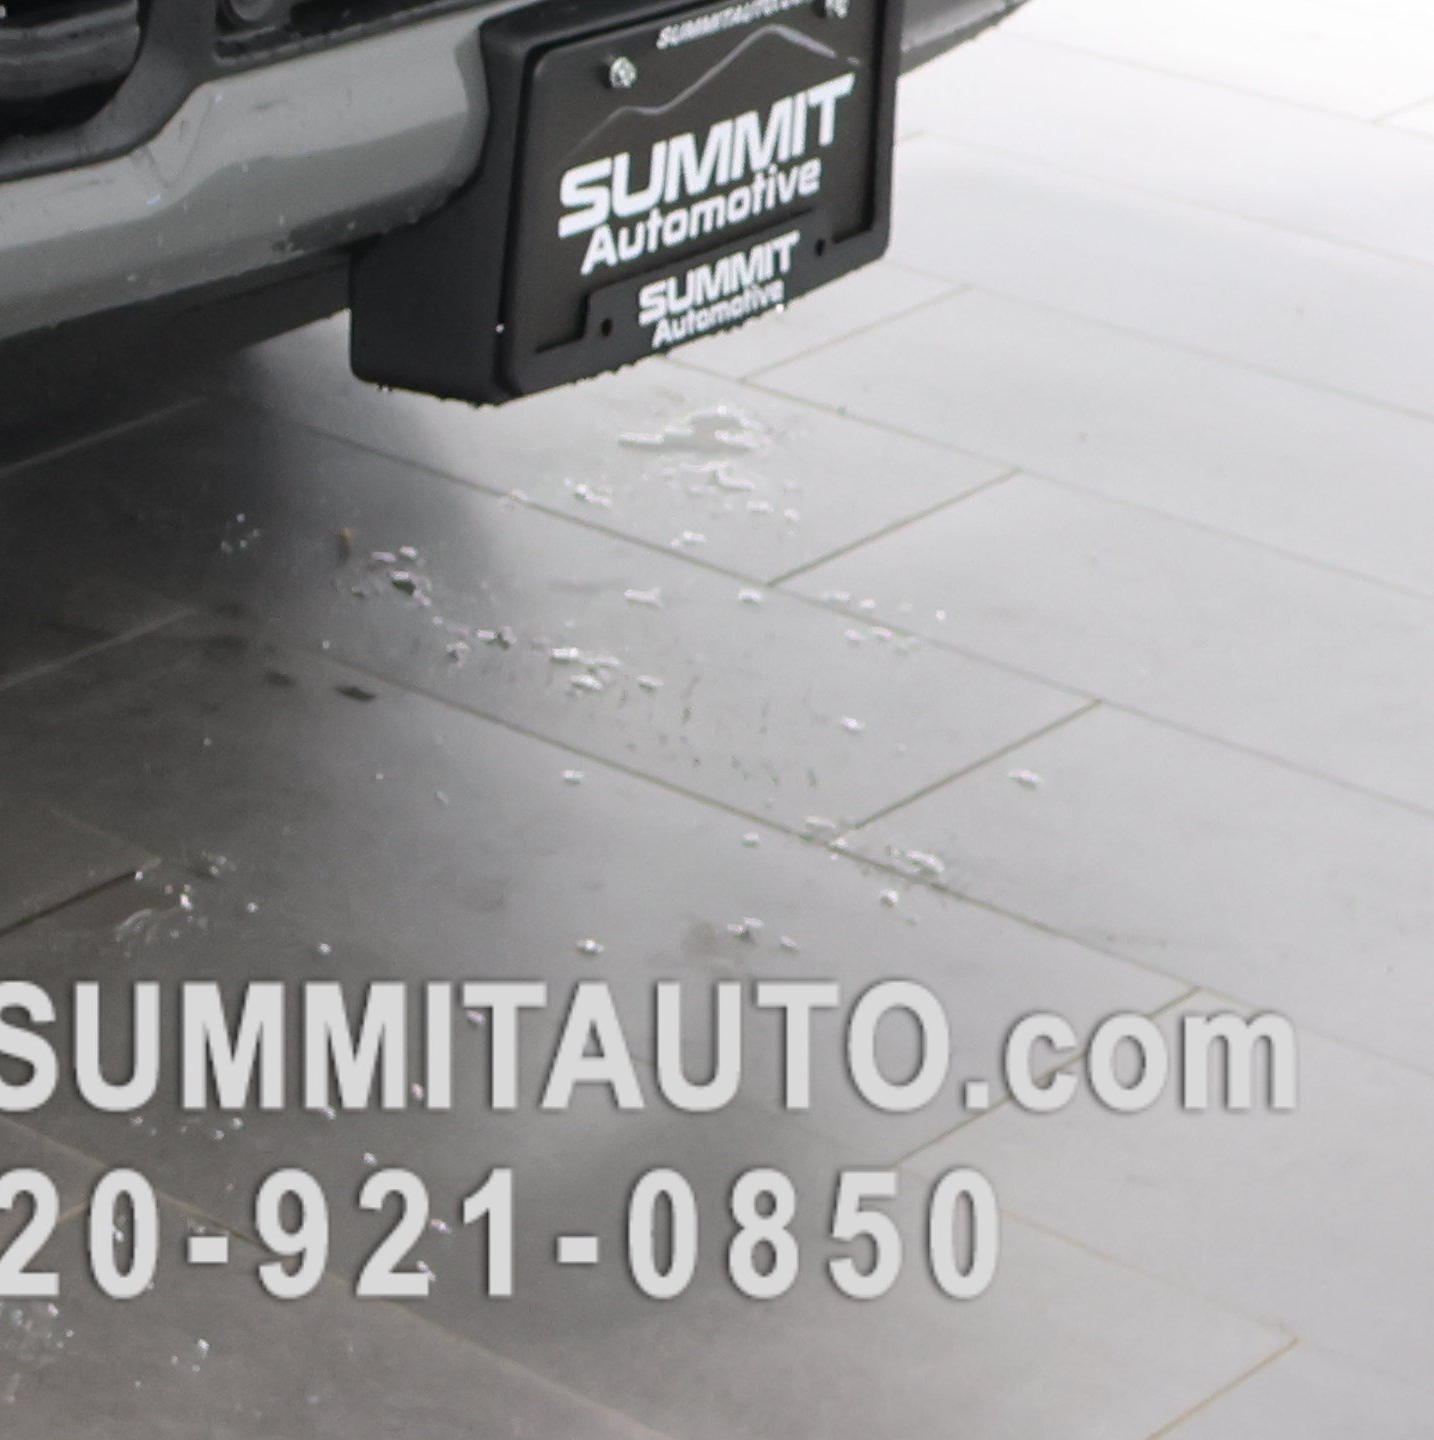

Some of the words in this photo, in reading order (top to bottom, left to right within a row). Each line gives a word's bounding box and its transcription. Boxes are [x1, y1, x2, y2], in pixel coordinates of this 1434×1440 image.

[557, 71, 856, 240] SUMMIT
[580, 156, 822, 277] Automotive
[637, 229, 801, 327] SUMMIT
[650, 277, 785, 349] Automotive
